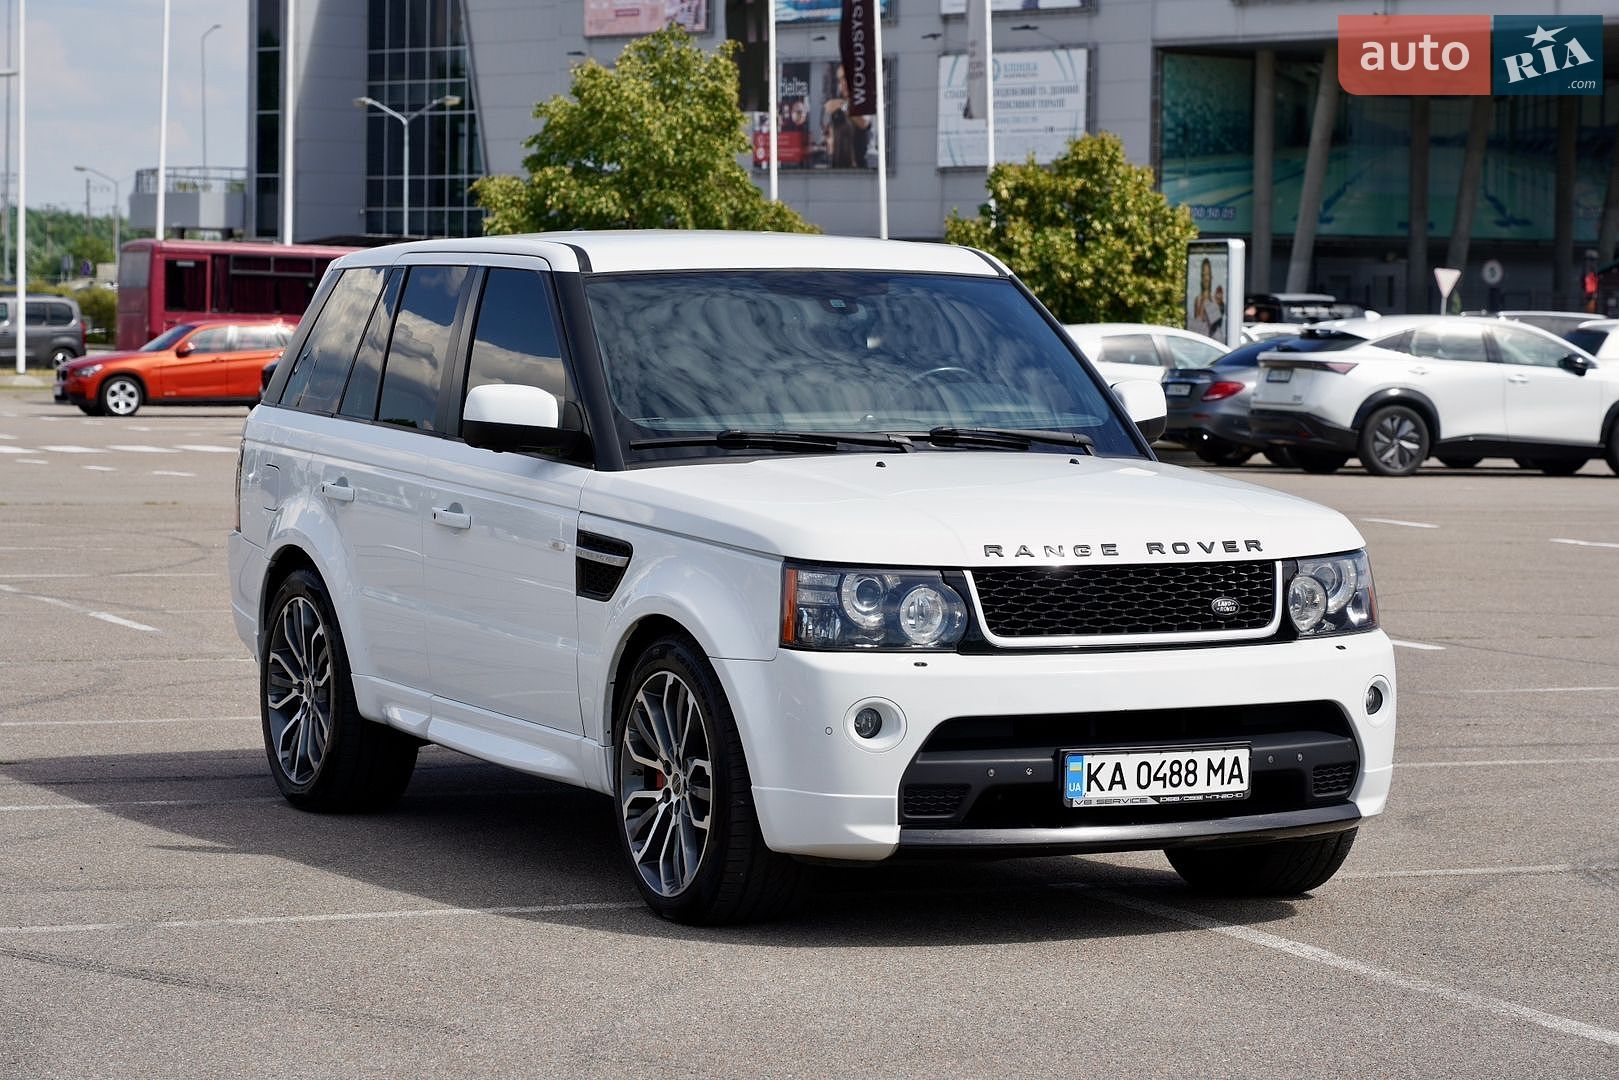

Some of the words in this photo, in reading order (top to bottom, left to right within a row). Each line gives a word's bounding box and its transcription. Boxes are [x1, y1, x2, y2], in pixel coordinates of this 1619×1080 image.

[983, 543, 1119, 558] RANGE
[1146, 539, 1263, 555] ROVER
[1086, 762, 1127, 792] KA
[1136, 758, 1198, 790] 0488
[1206, 756, 1244, 787] MA
[1069, 783, 1082, 792] UA
[1096, 797, 1148, 805] SERVICE
